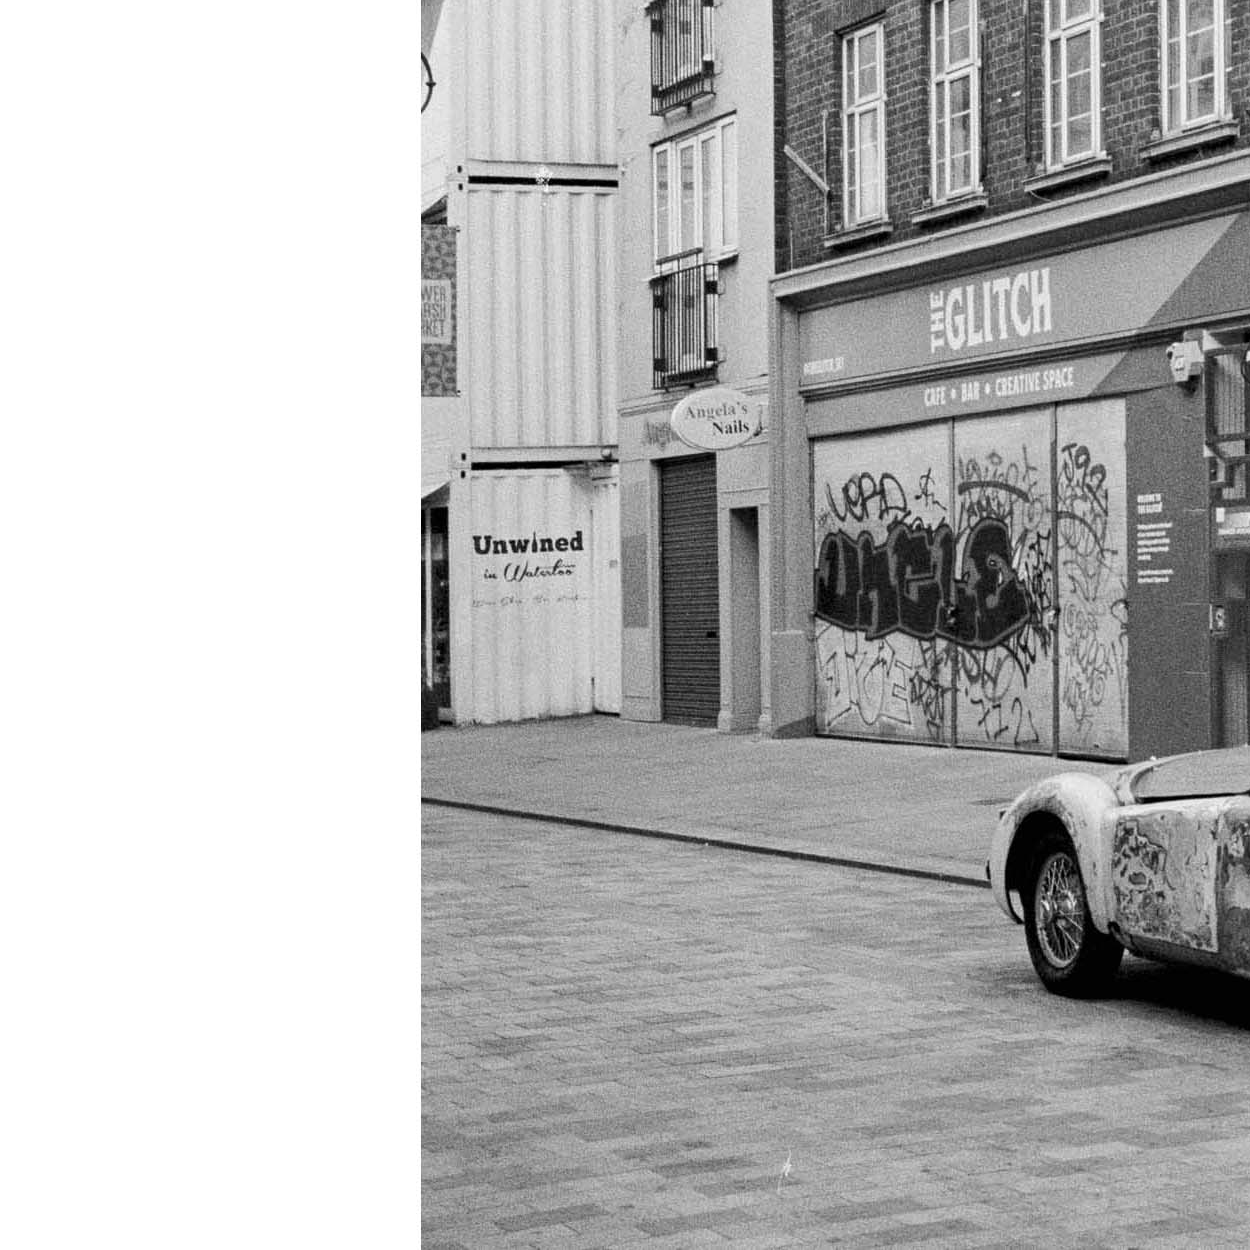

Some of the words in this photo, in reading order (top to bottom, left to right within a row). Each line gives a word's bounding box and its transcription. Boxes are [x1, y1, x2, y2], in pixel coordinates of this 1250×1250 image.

[930, 290, 945, 354] THE
[945, 267, 1052, 351] GLITCH
[923, 385, 946, 407] CAFE
[961, 381, 980, 403] BAR
[995, 371, 1041, 397] CREATIVE
[1043, 366, 1075, 391] SPACE
[684, 400, 748, 422] Angela's
[712, 419, 750, 435] Nails
[472, 530, 584, 555] Unwined
[484, 568, 498, 579] in
[504, 558, 576, 582] Waterloo
